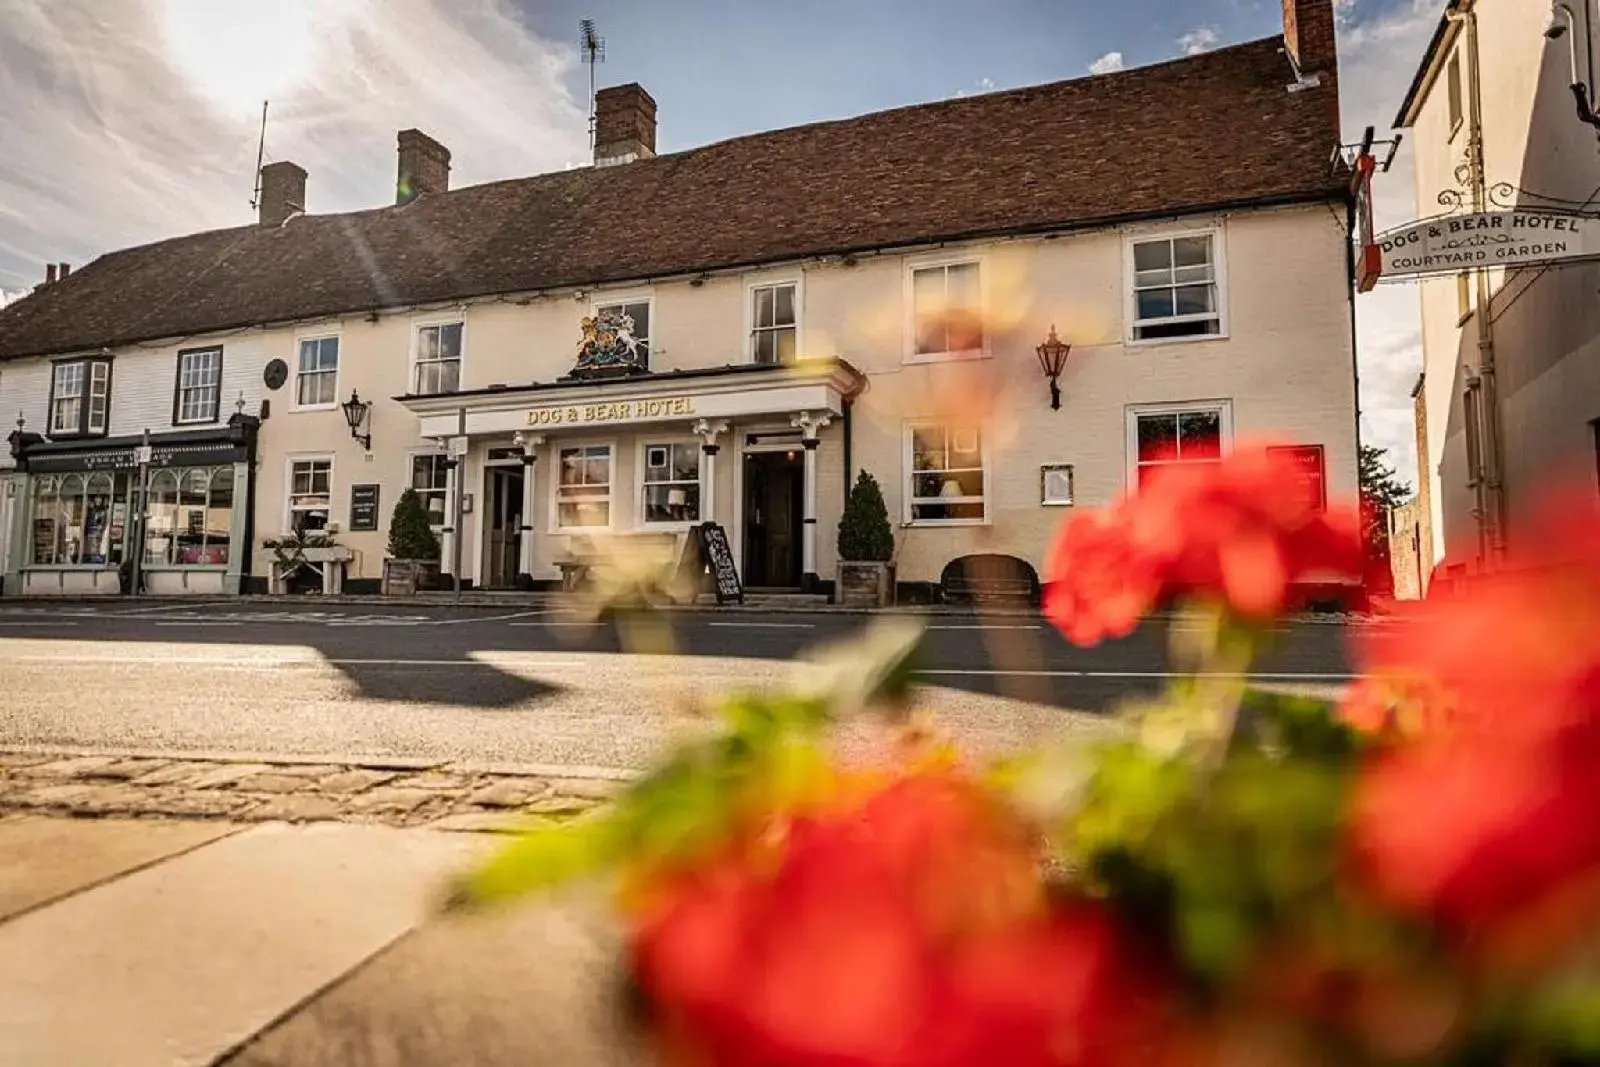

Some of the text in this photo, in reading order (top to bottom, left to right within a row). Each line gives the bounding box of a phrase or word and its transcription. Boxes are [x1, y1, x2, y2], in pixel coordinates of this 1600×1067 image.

[1381, 215, 1580, 253] DOG & BEAR HOTEL
[1391, 241, 1567, 269] COURTYARD GARDEN
[527, 397, 696, 426] DOG & BEAR HOTEL
